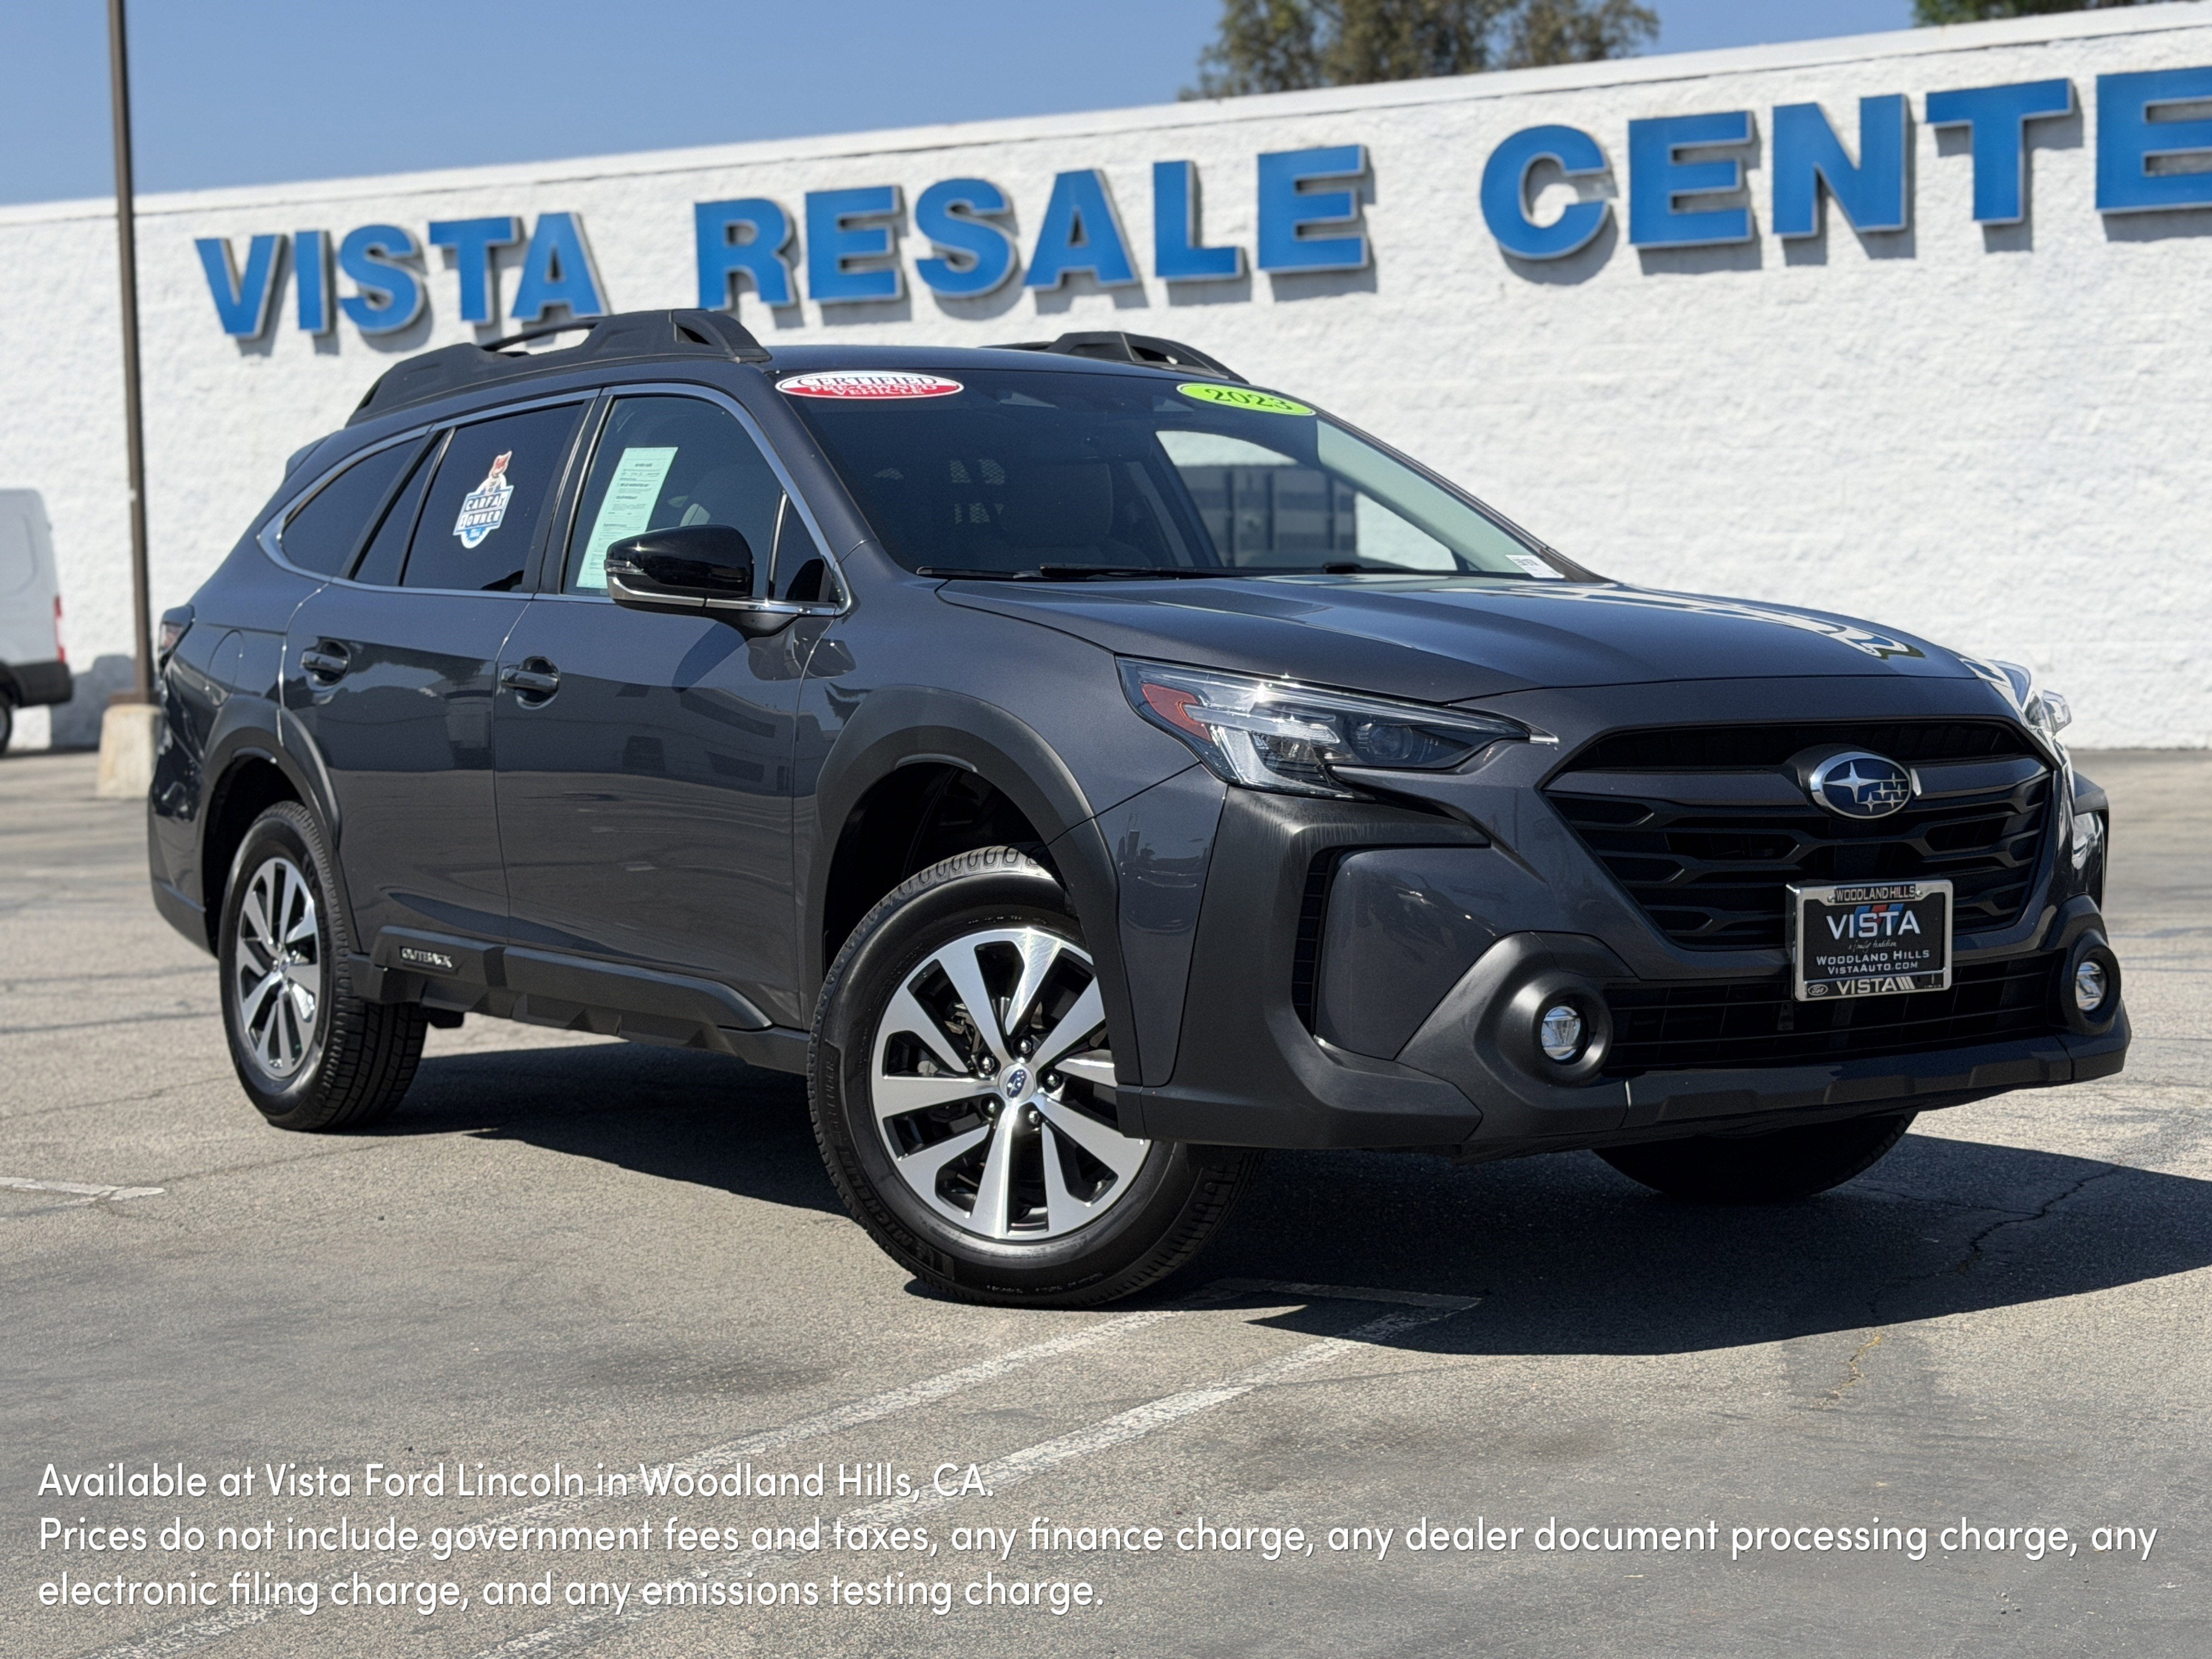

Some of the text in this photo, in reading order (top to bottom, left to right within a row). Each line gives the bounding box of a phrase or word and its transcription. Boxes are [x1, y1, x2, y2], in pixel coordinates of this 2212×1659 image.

[194, 212, 608, 338] VISTA
[693, 143, 1369, 311] RESALE
[797, 377, 937, 386] CERTIFIED
[832, 387, 924, 396] VEHICLE
[1205, 388, 1293, 410] 2023
[466, 492, 509, 511] CARFAX
[1836, 885, 1916, 902] WOODLAND HILLS
[1826, 910, 1921, 940] VISTA
[1816, 950, 1930, 966] WOODLAND HILLS
[1836, 977, 1898, 995] VISTA
